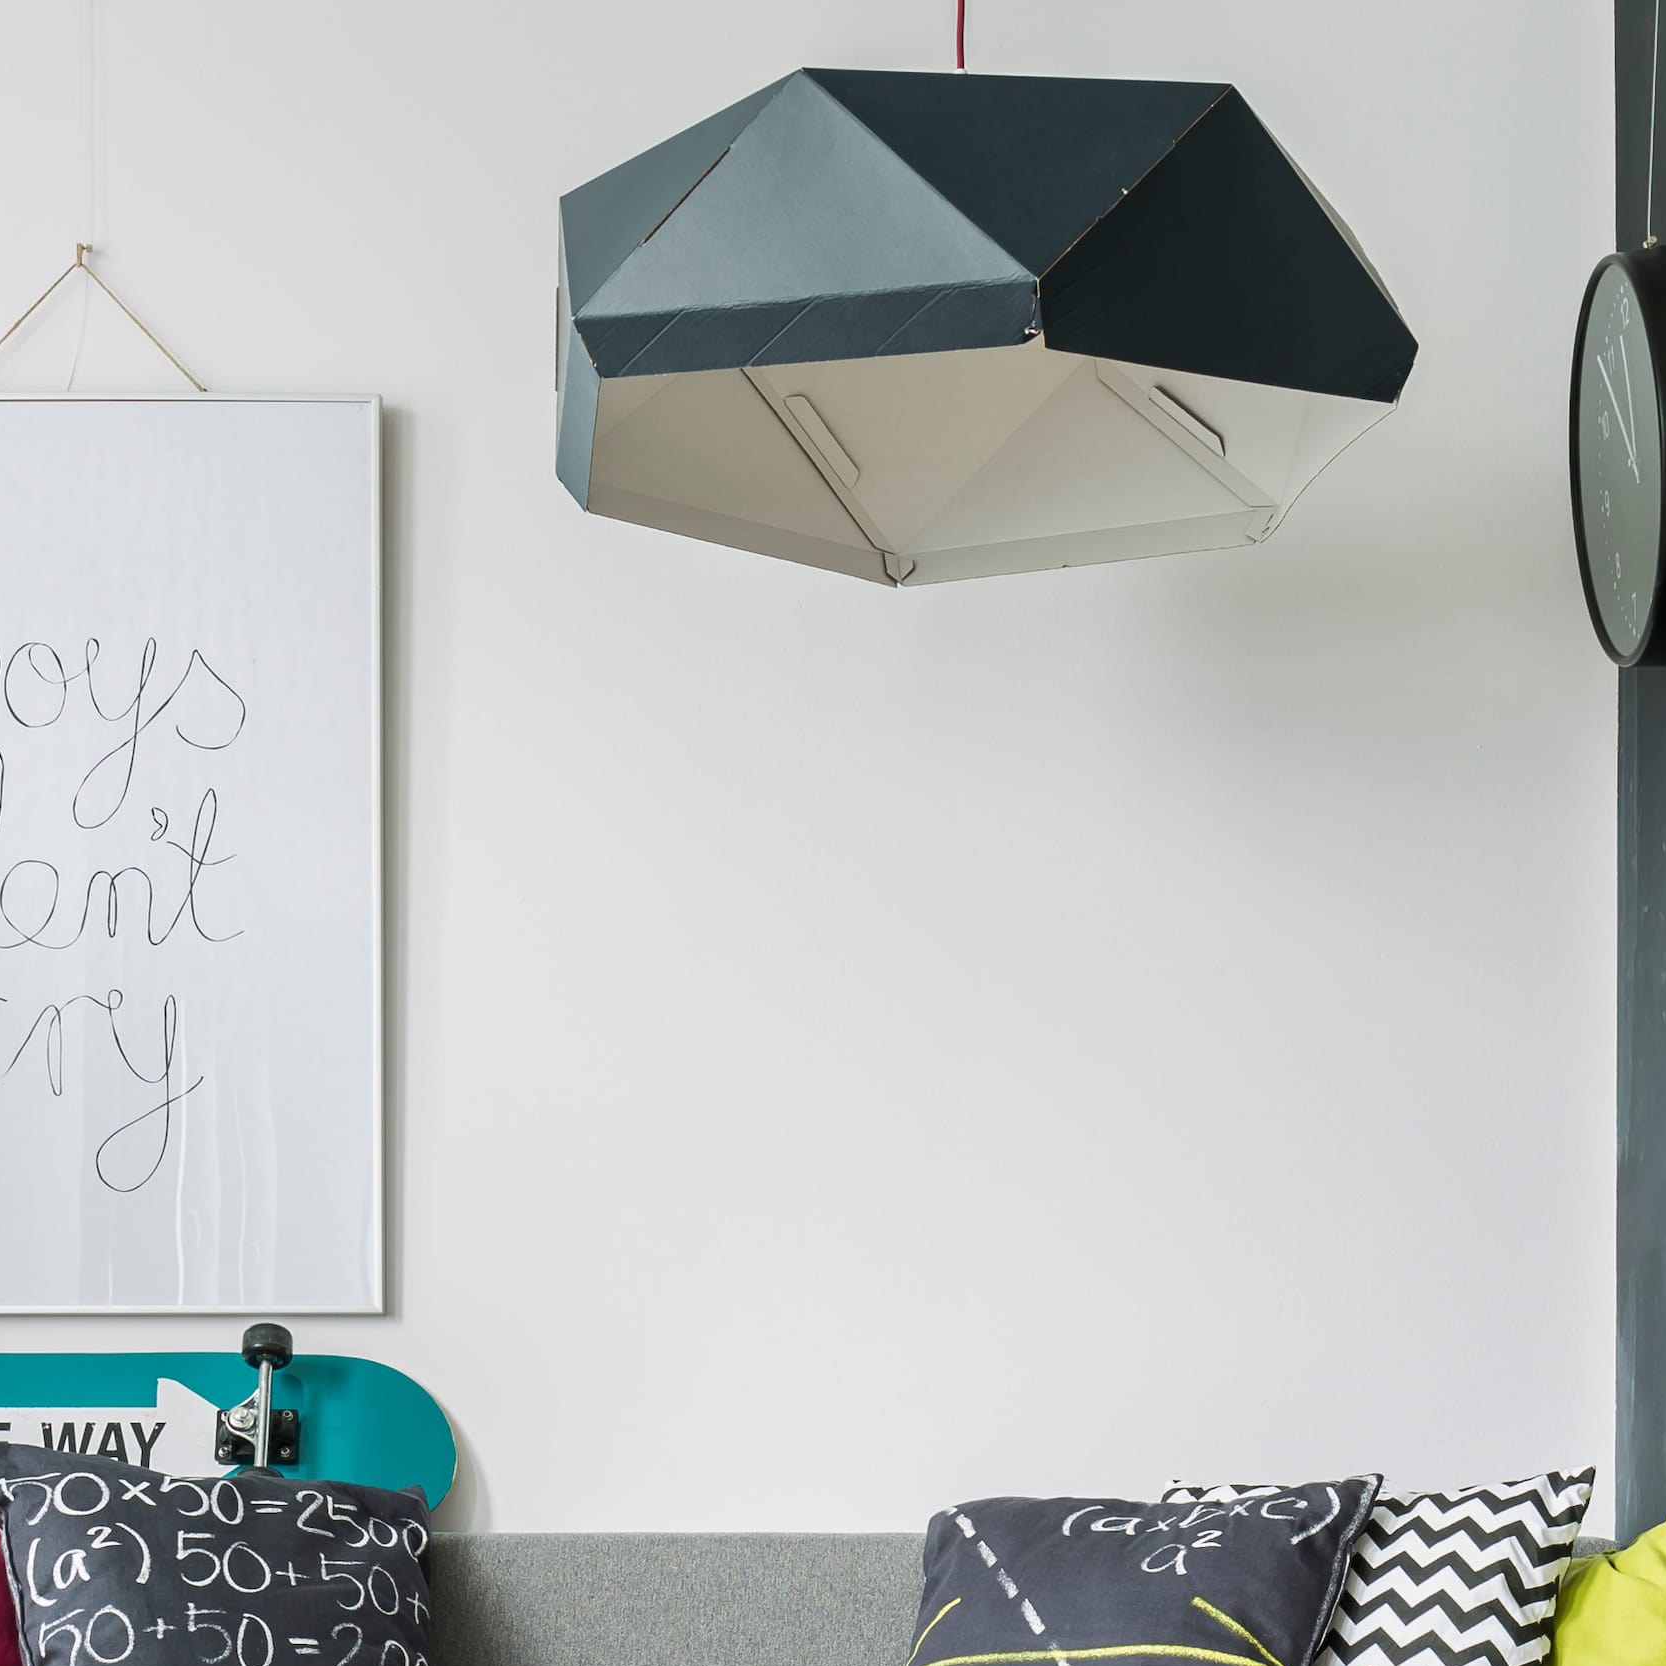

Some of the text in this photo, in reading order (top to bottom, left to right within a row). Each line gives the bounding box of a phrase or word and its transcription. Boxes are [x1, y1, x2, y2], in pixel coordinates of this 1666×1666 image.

[1621, 297, 1630, 330] 12
[1606, 344, 1615, 374] 11
[1615, 551, 1621, 580] 8
